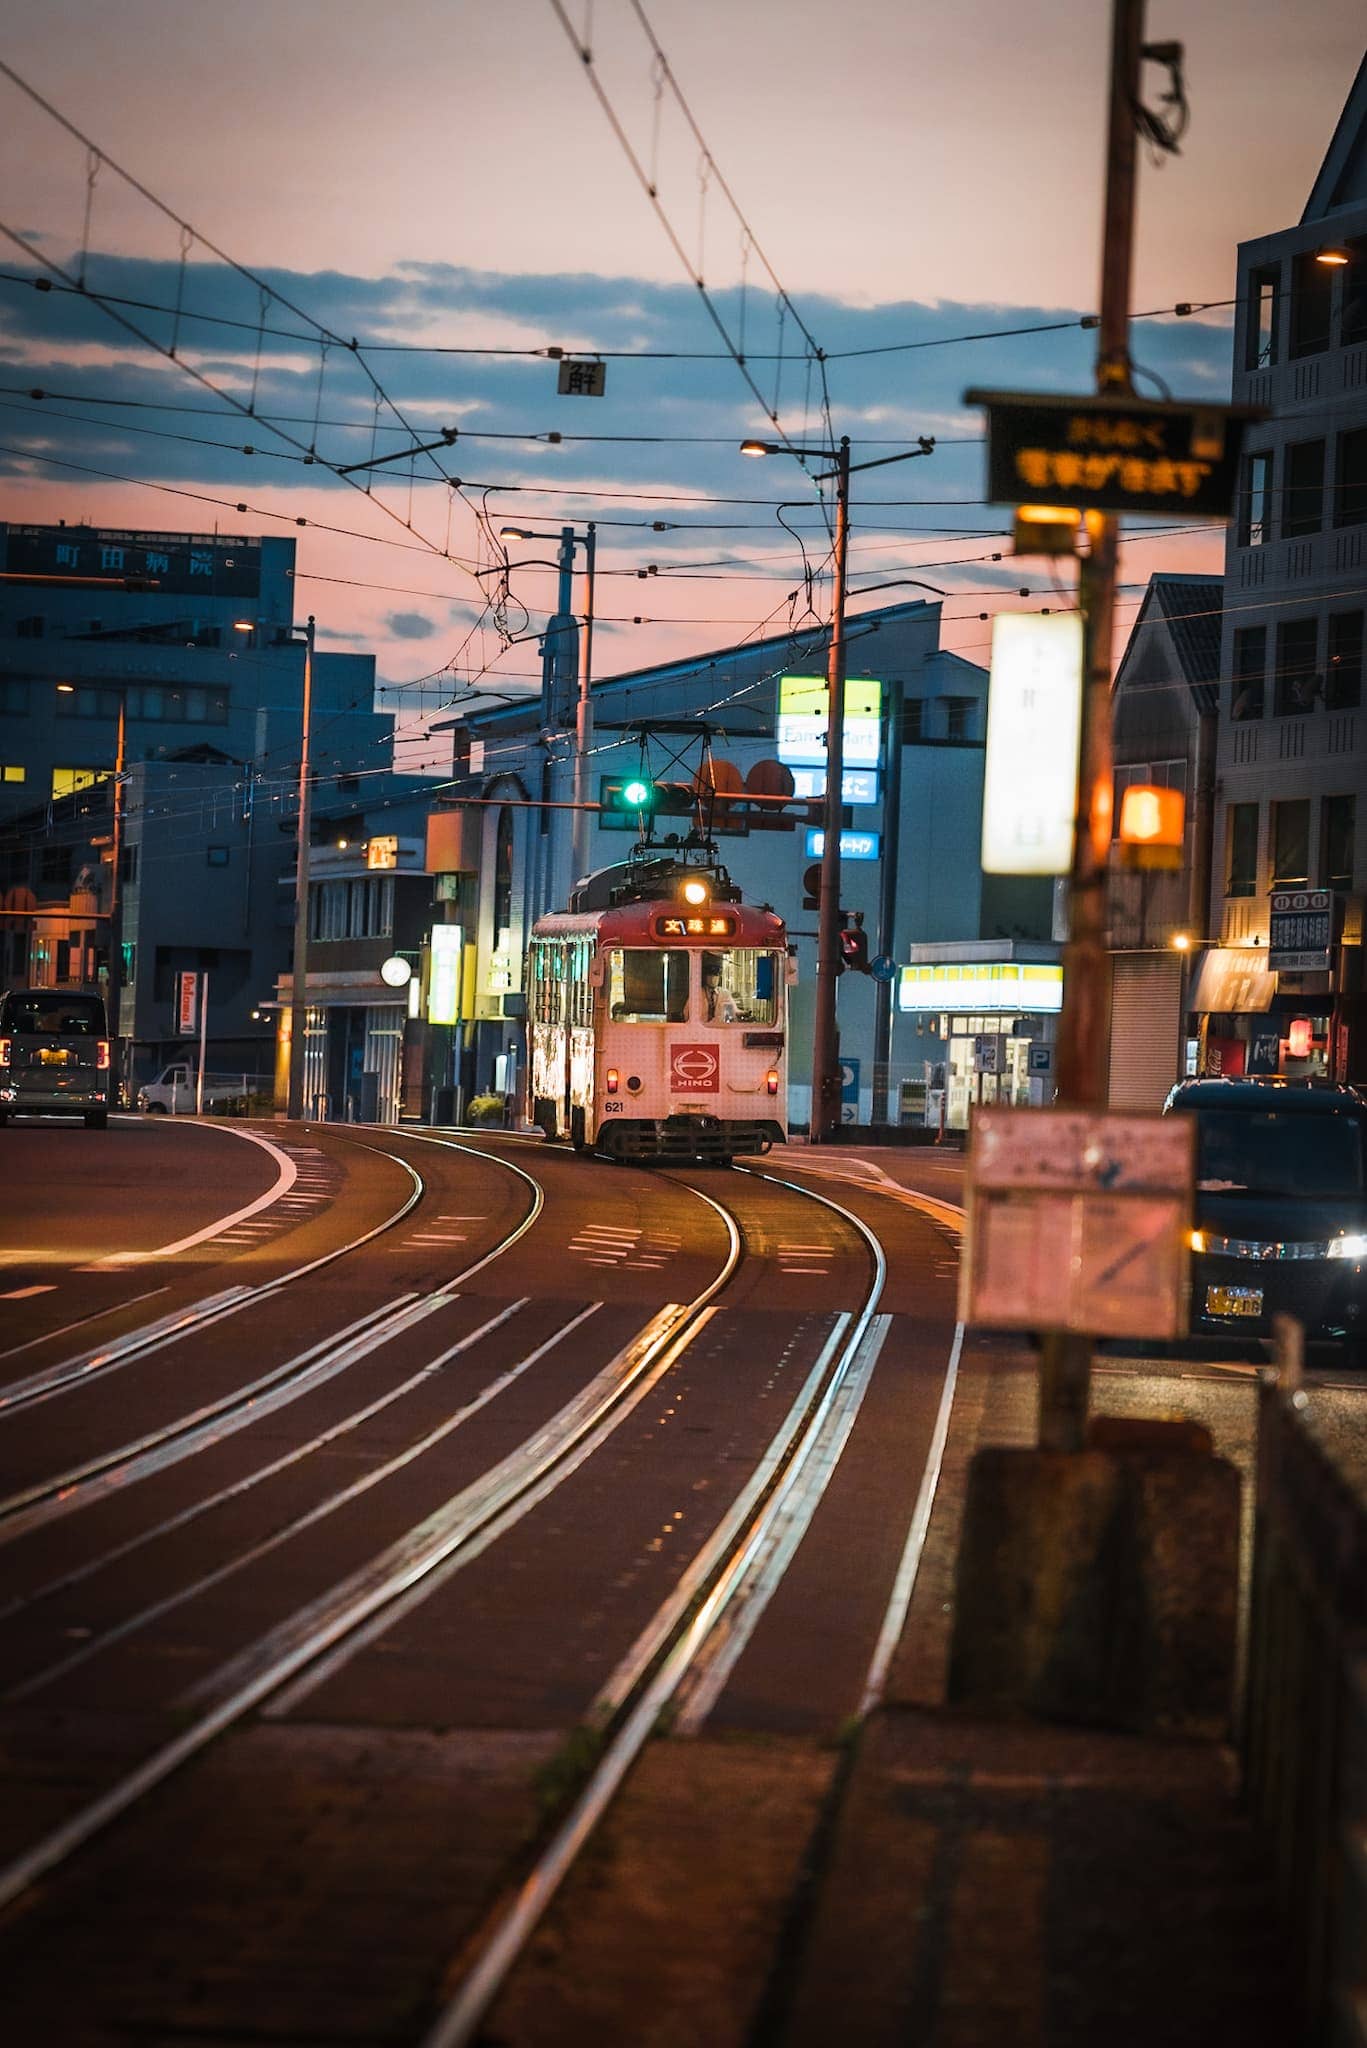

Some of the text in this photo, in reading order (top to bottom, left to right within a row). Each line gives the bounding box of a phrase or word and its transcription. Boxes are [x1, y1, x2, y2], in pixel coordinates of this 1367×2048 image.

[56, 544, 214, 576] 町田病院
[183, 976, 195, 1021] Paloma
[1033, 1051, 1048, 1067] P
[605, 1102, 623, 1113] 621
